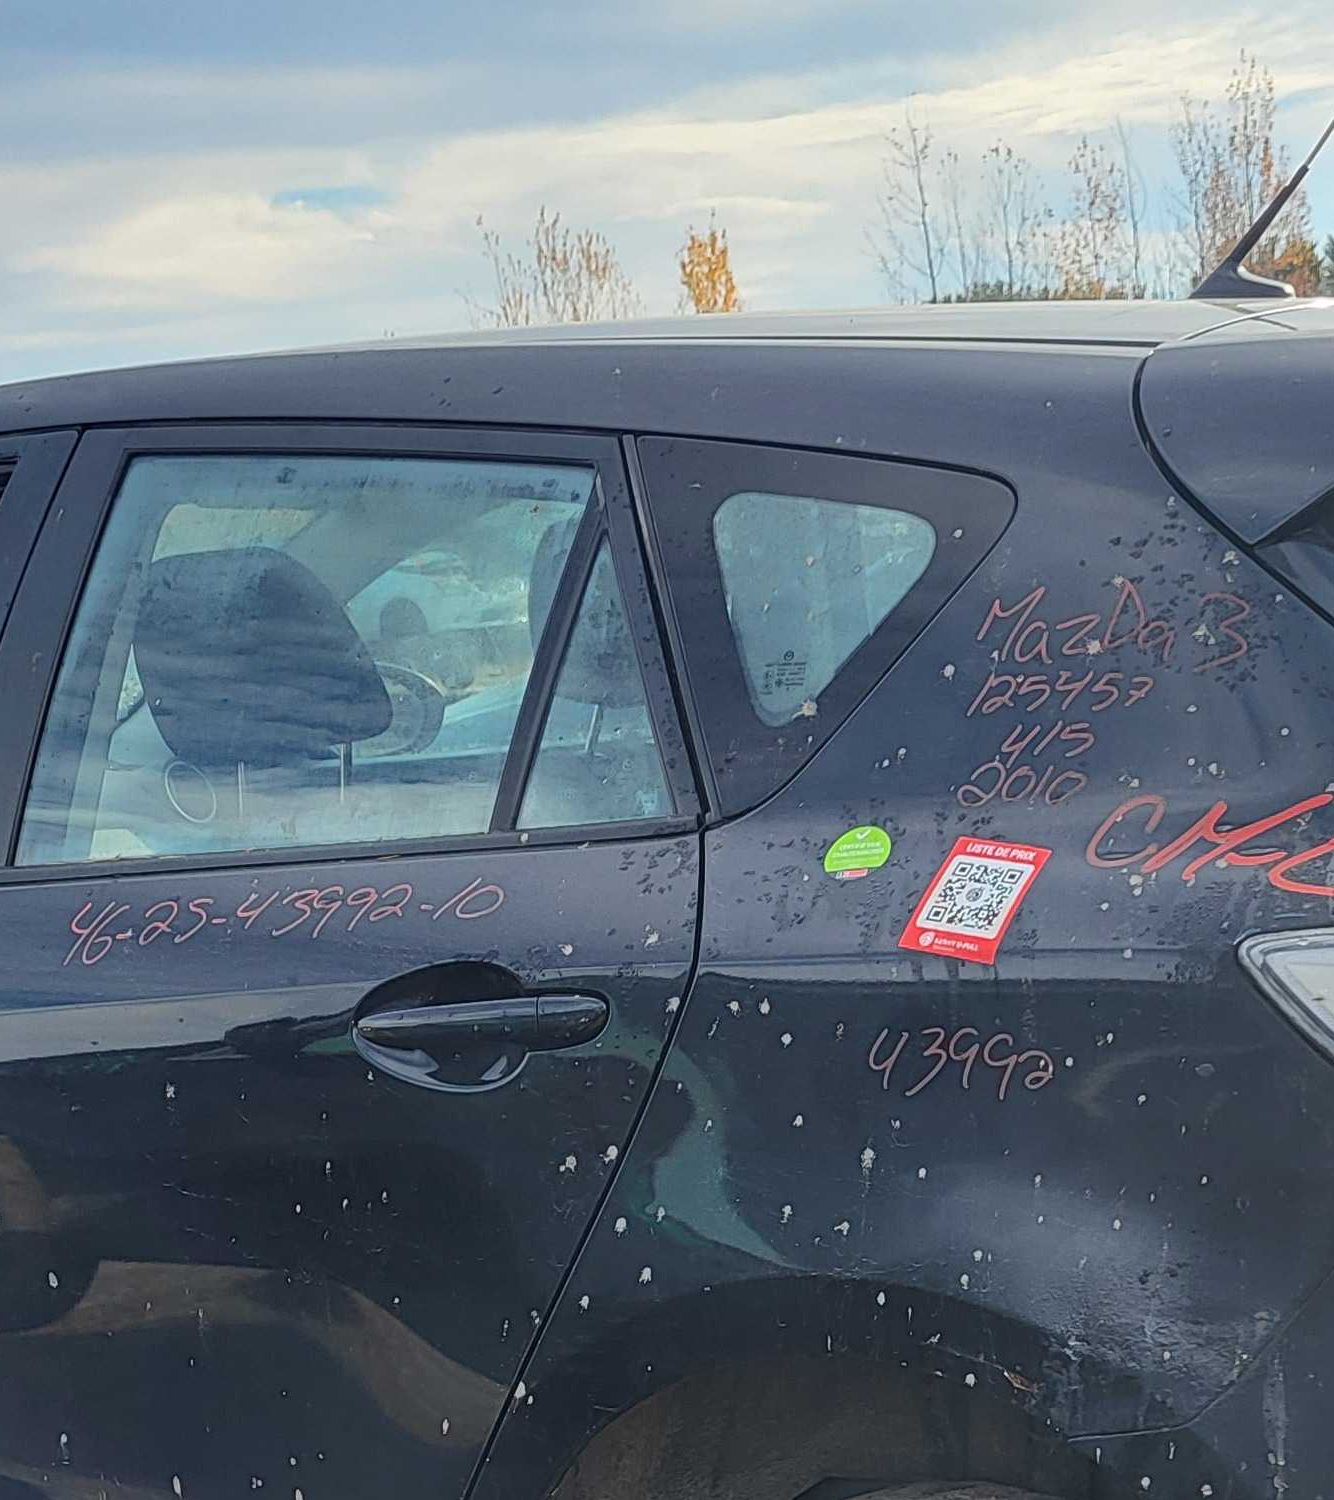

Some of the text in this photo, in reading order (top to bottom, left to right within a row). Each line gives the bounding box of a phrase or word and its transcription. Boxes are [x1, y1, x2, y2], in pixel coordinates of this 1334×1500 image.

[1193, 592, 1251, 673] 3
[1000, 720, 1095, 769] 415
[956, 761, 1088, 808] 2010
[966, 842, 1037, 862] LISTE DE PRIX
